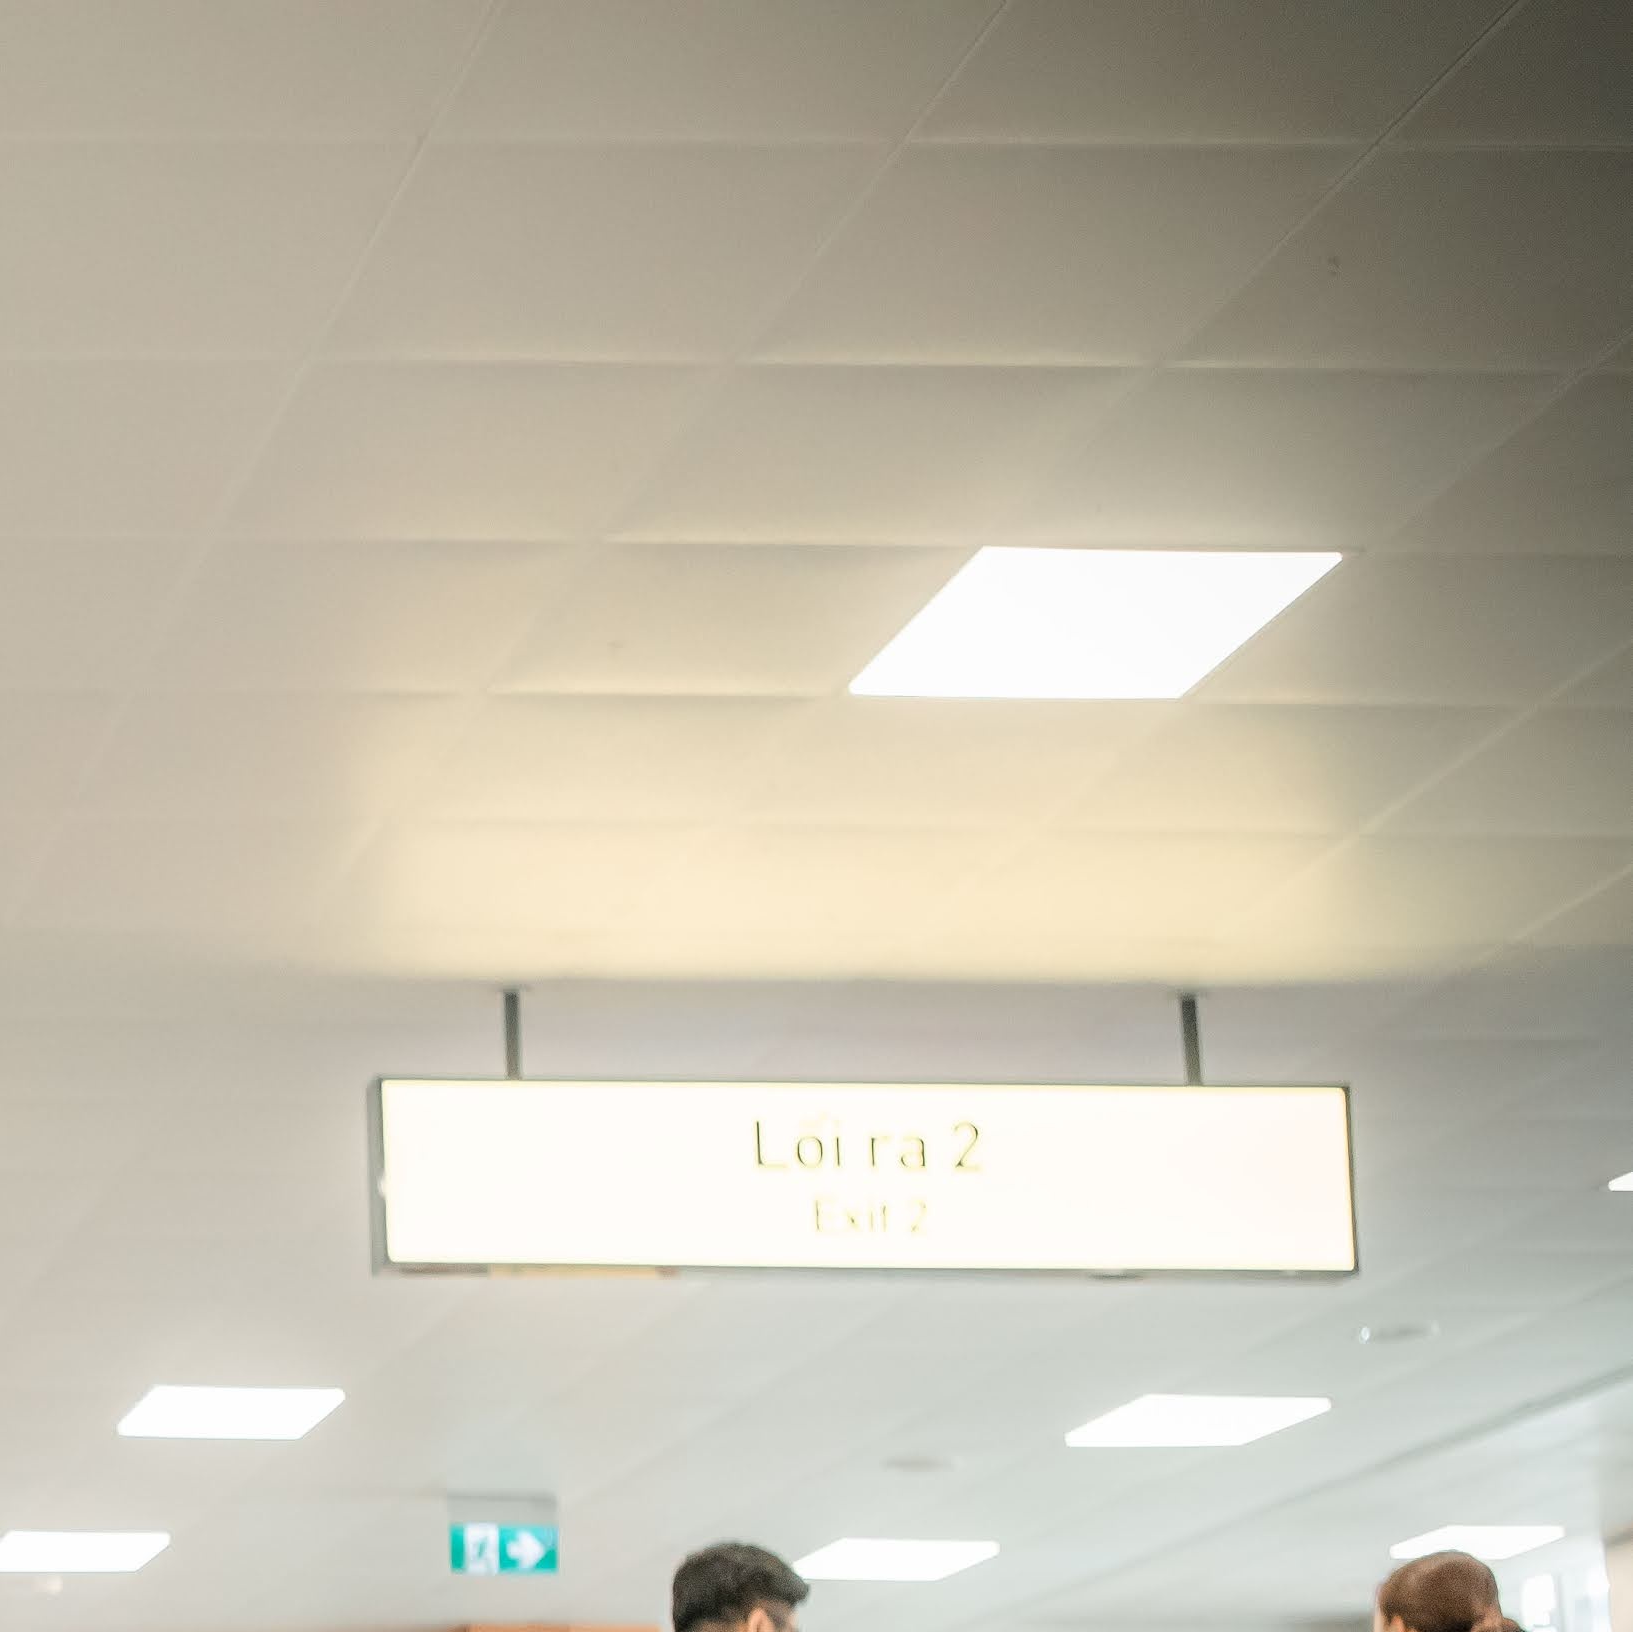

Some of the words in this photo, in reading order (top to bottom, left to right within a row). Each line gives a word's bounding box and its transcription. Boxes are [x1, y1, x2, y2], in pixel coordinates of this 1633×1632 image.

[865, 1130, 929, 1171] ra
[949, 1117, 985, 1172] 2
[812, 1194, 892, 1234] Exit
[908, 1195, 929, 1236] 2
